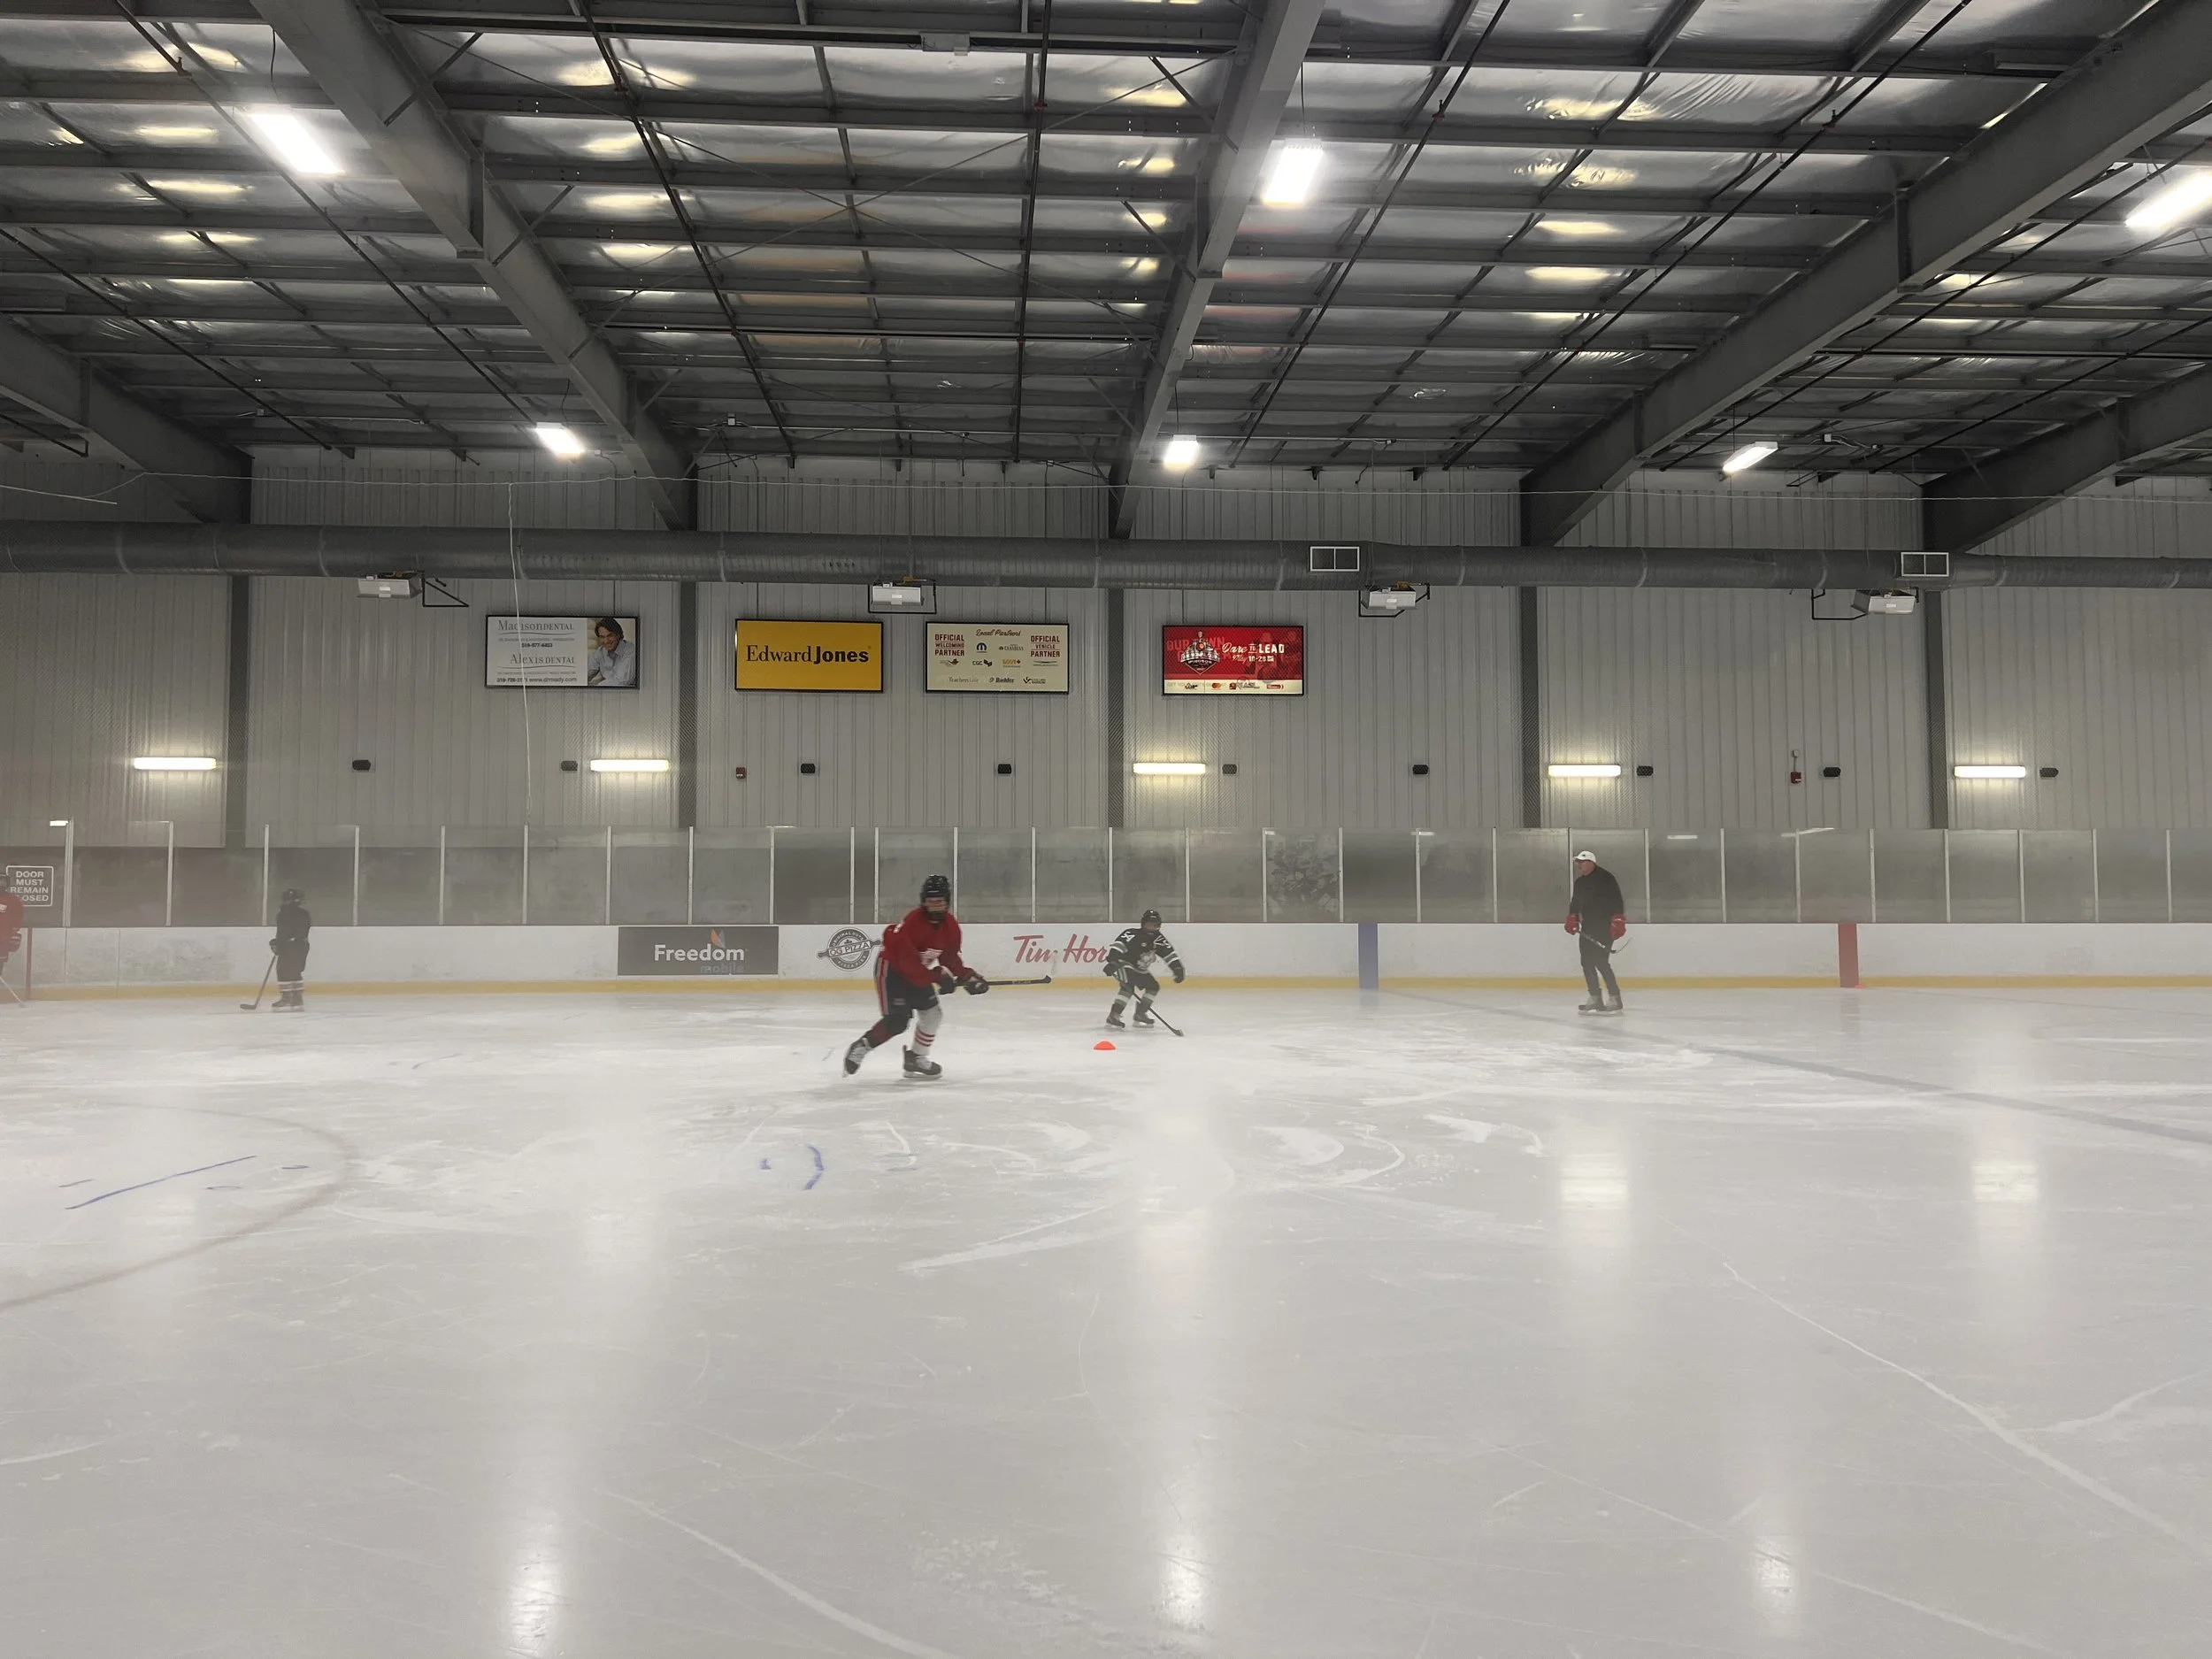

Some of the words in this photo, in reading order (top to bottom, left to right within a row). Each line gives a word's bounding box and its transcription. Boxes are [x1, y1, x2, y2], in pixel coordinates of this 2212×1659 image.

[1221, 641, 1248, 654] Dare
[1258, 643, 1285, 654] LEAD
[654, 944, 744, 962] Freedom
[844, 941, 870, 953] PIZZA
[700, 962, 744, 974] mobile
